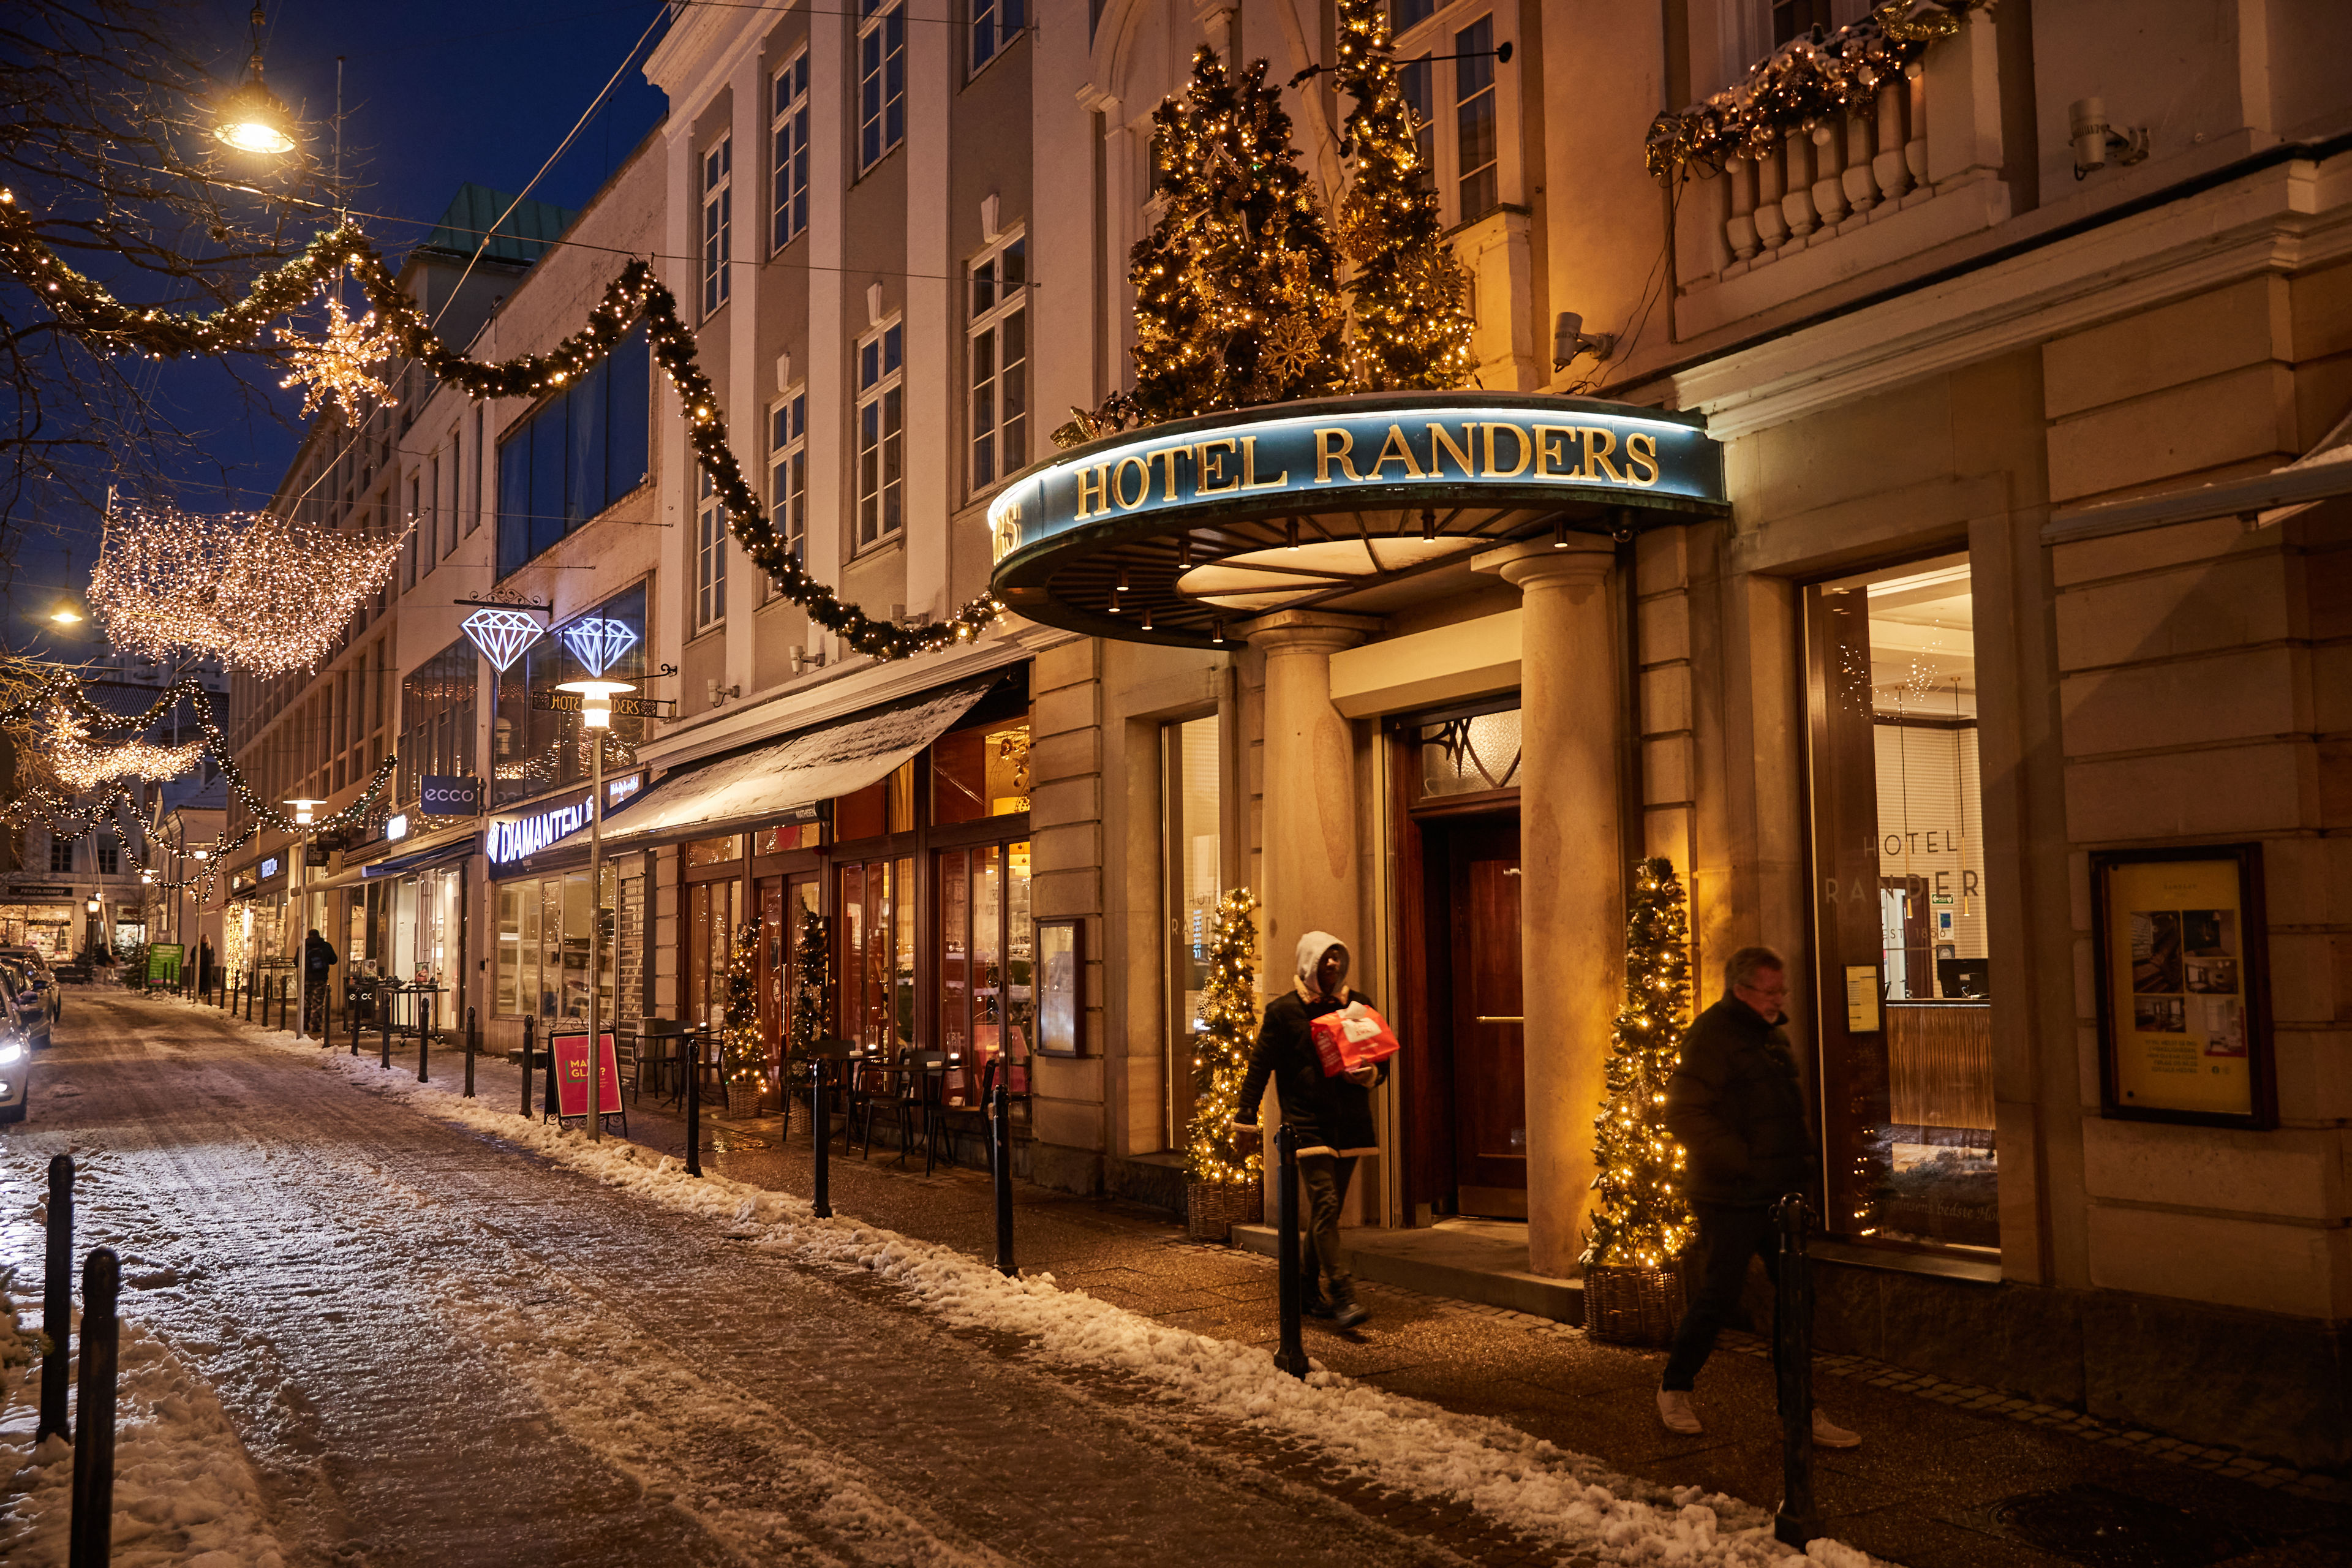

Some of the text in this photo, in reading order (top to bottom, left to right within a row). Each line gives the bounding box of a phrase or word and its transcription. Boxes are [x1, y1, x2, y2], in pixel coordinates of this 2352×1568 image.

[1074, 423, 1659, 521] HOTEL RANDERS
[551, 695, 639, 715] HOTE DERS
[424, 788, 474, 802] ecco
[500, 804, 582, 863] DIAMANTEN
[1864, 830, 1958, 858] HOTEL
[1171, 916, 1213, 935] RAD
[1915, 926, 1946, 938] 1856
[570, 1058, 589, 1068] MA
[571, 1067, 606, 1077] GL?
[1938, 1200, 1973, 1219] bedste
